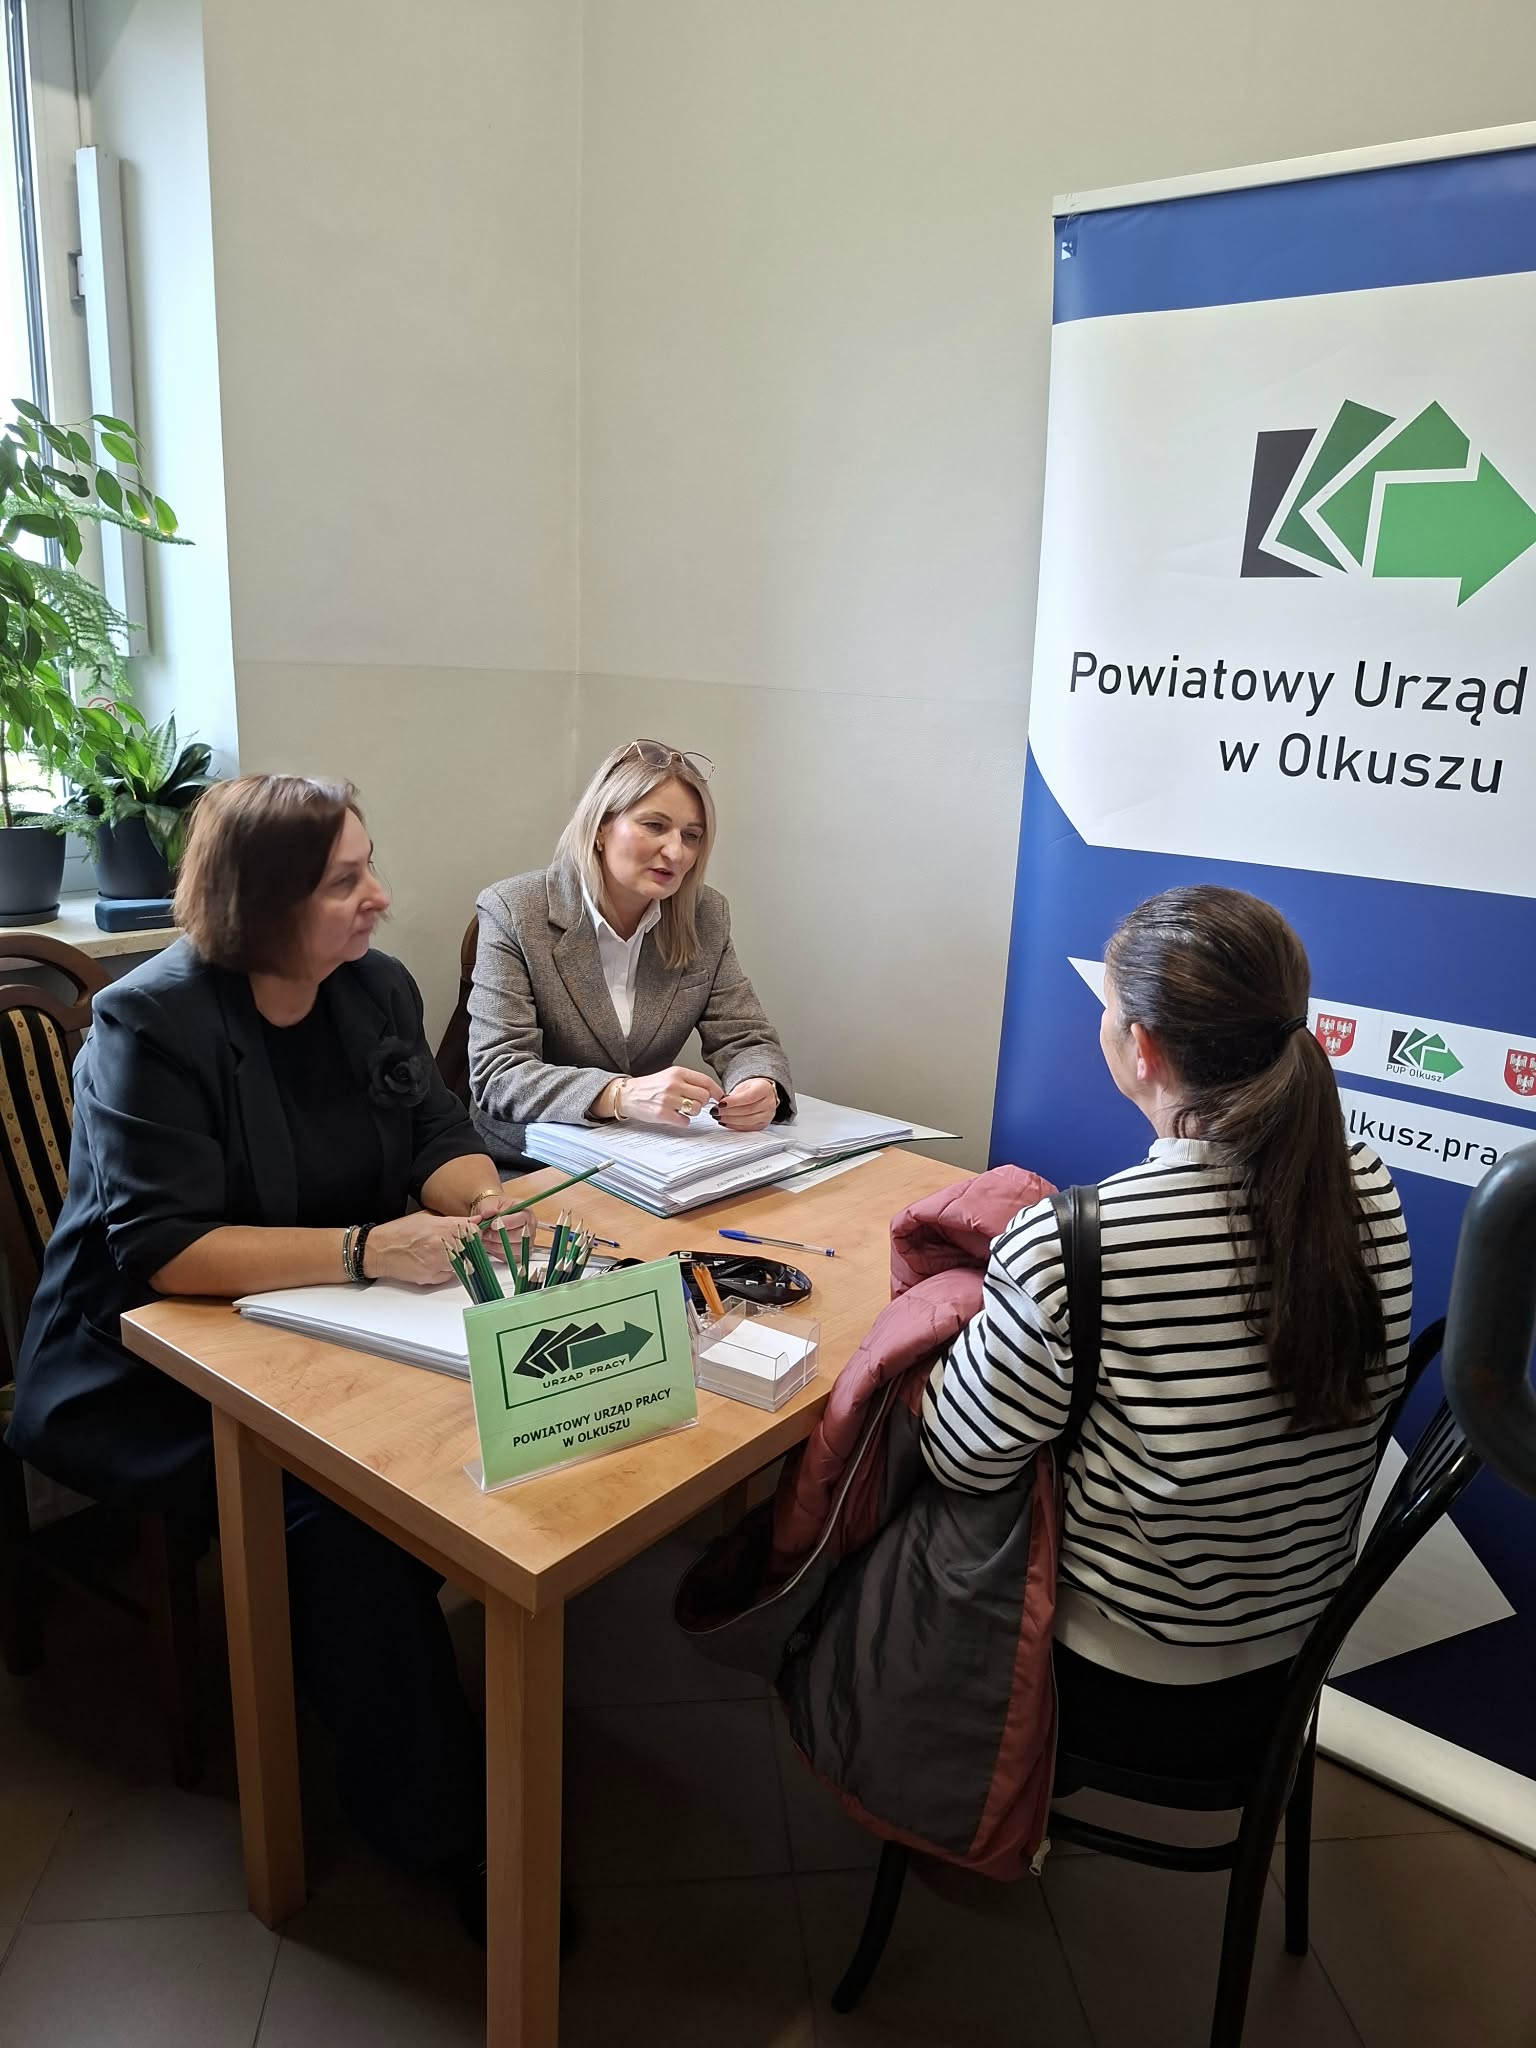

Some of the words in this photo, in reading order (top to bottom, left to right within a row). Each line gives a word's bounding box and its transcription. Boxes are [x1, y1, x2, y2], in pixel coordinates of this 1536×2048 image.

[1069, 651, 1336, 717] Powiatowy
[1353, 660, 1529, 727] Urząd
[1218, 739, 1260, 773] w
[1278, 732, 1504, 794] Olkuszu
[1386, 1063, 1407, 1075] PUP
[1409, 1068, 1443, 1083] Olkusz
[1349, 1109, 1508, 1166] lkusz.pra
[542, 1370, 584, 1389] URZĄD
[589, 1358, 627, 1376] PRACY
[512, 1413, 591, 1448] POWIATOWY
[594, 1401, 633, 1422] URZĄD
[635, 1387, 672, 1408] PRACY
[562, 1435, 575, 1448] W
[577, 1417, 631, 1443] OLKUSZU
